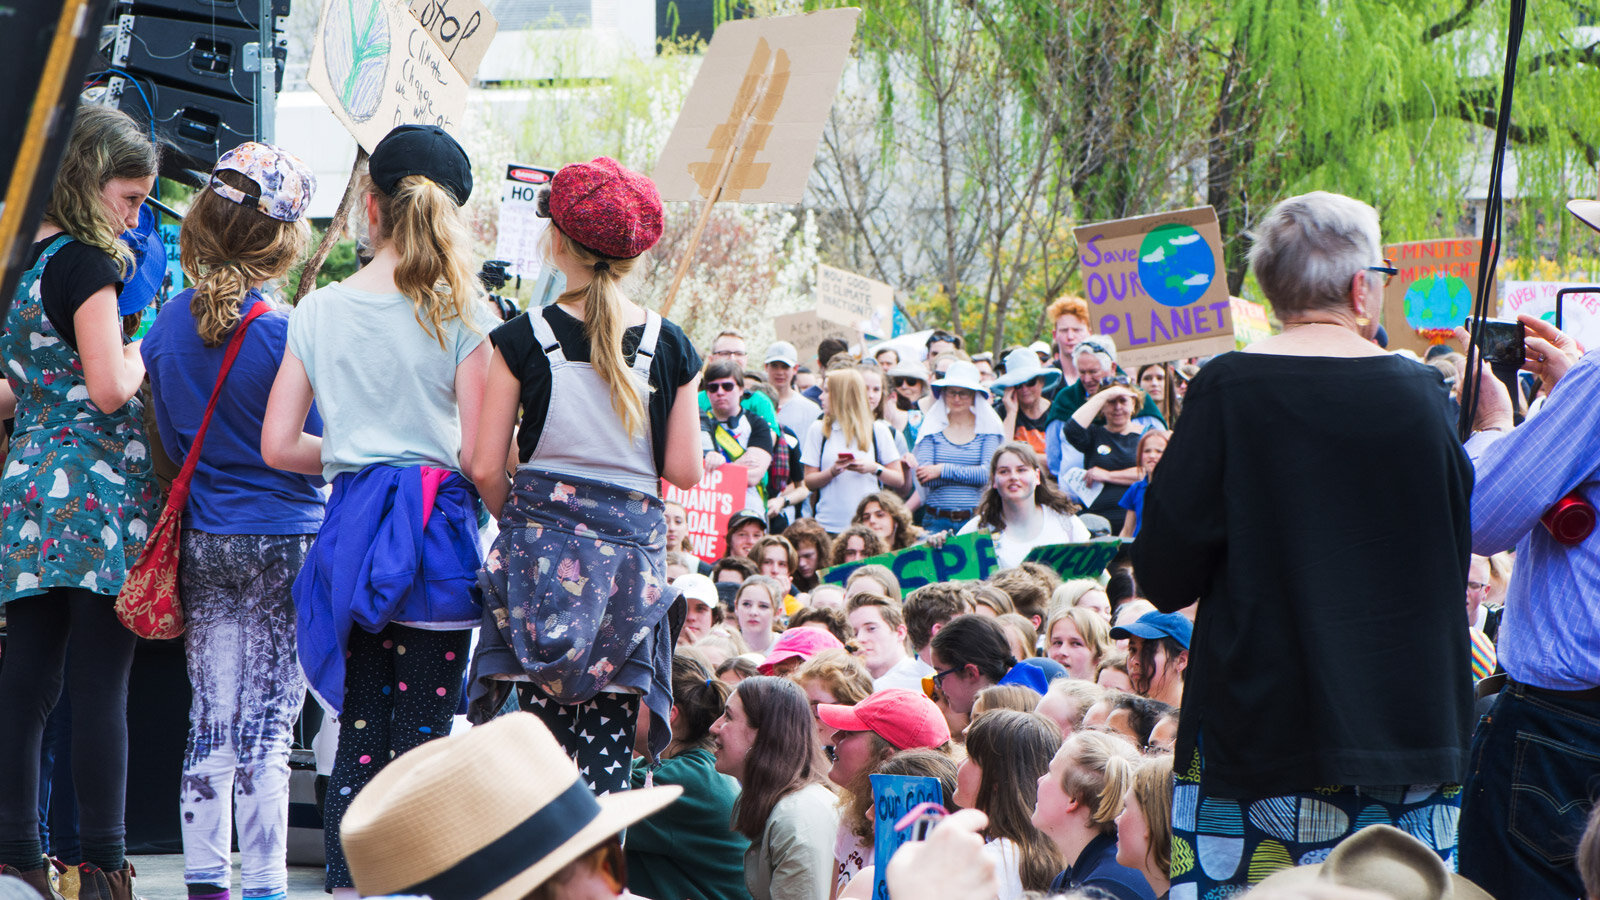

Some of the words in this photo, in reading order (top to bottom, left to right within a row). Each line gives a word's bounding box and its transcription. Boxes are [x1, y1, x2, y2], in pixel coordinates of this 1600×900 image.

[1081, 234, 1138, 268] Save
[1387, 247, 1398, 262] 2
[1402, 240, 1473, 260] MINUTES
[1401, 261, 1479, 284] MIDNIGHT
[832, 283, 872, 306] CLIMATE
[1087, 271, 1147, 305] OUR
[1508, 285, 1536, 311] OPEN
[1099, 301, 1230, 346] PLANET
[687, 510, 719, 536] OAL
[879, 794, 901, 821] our
